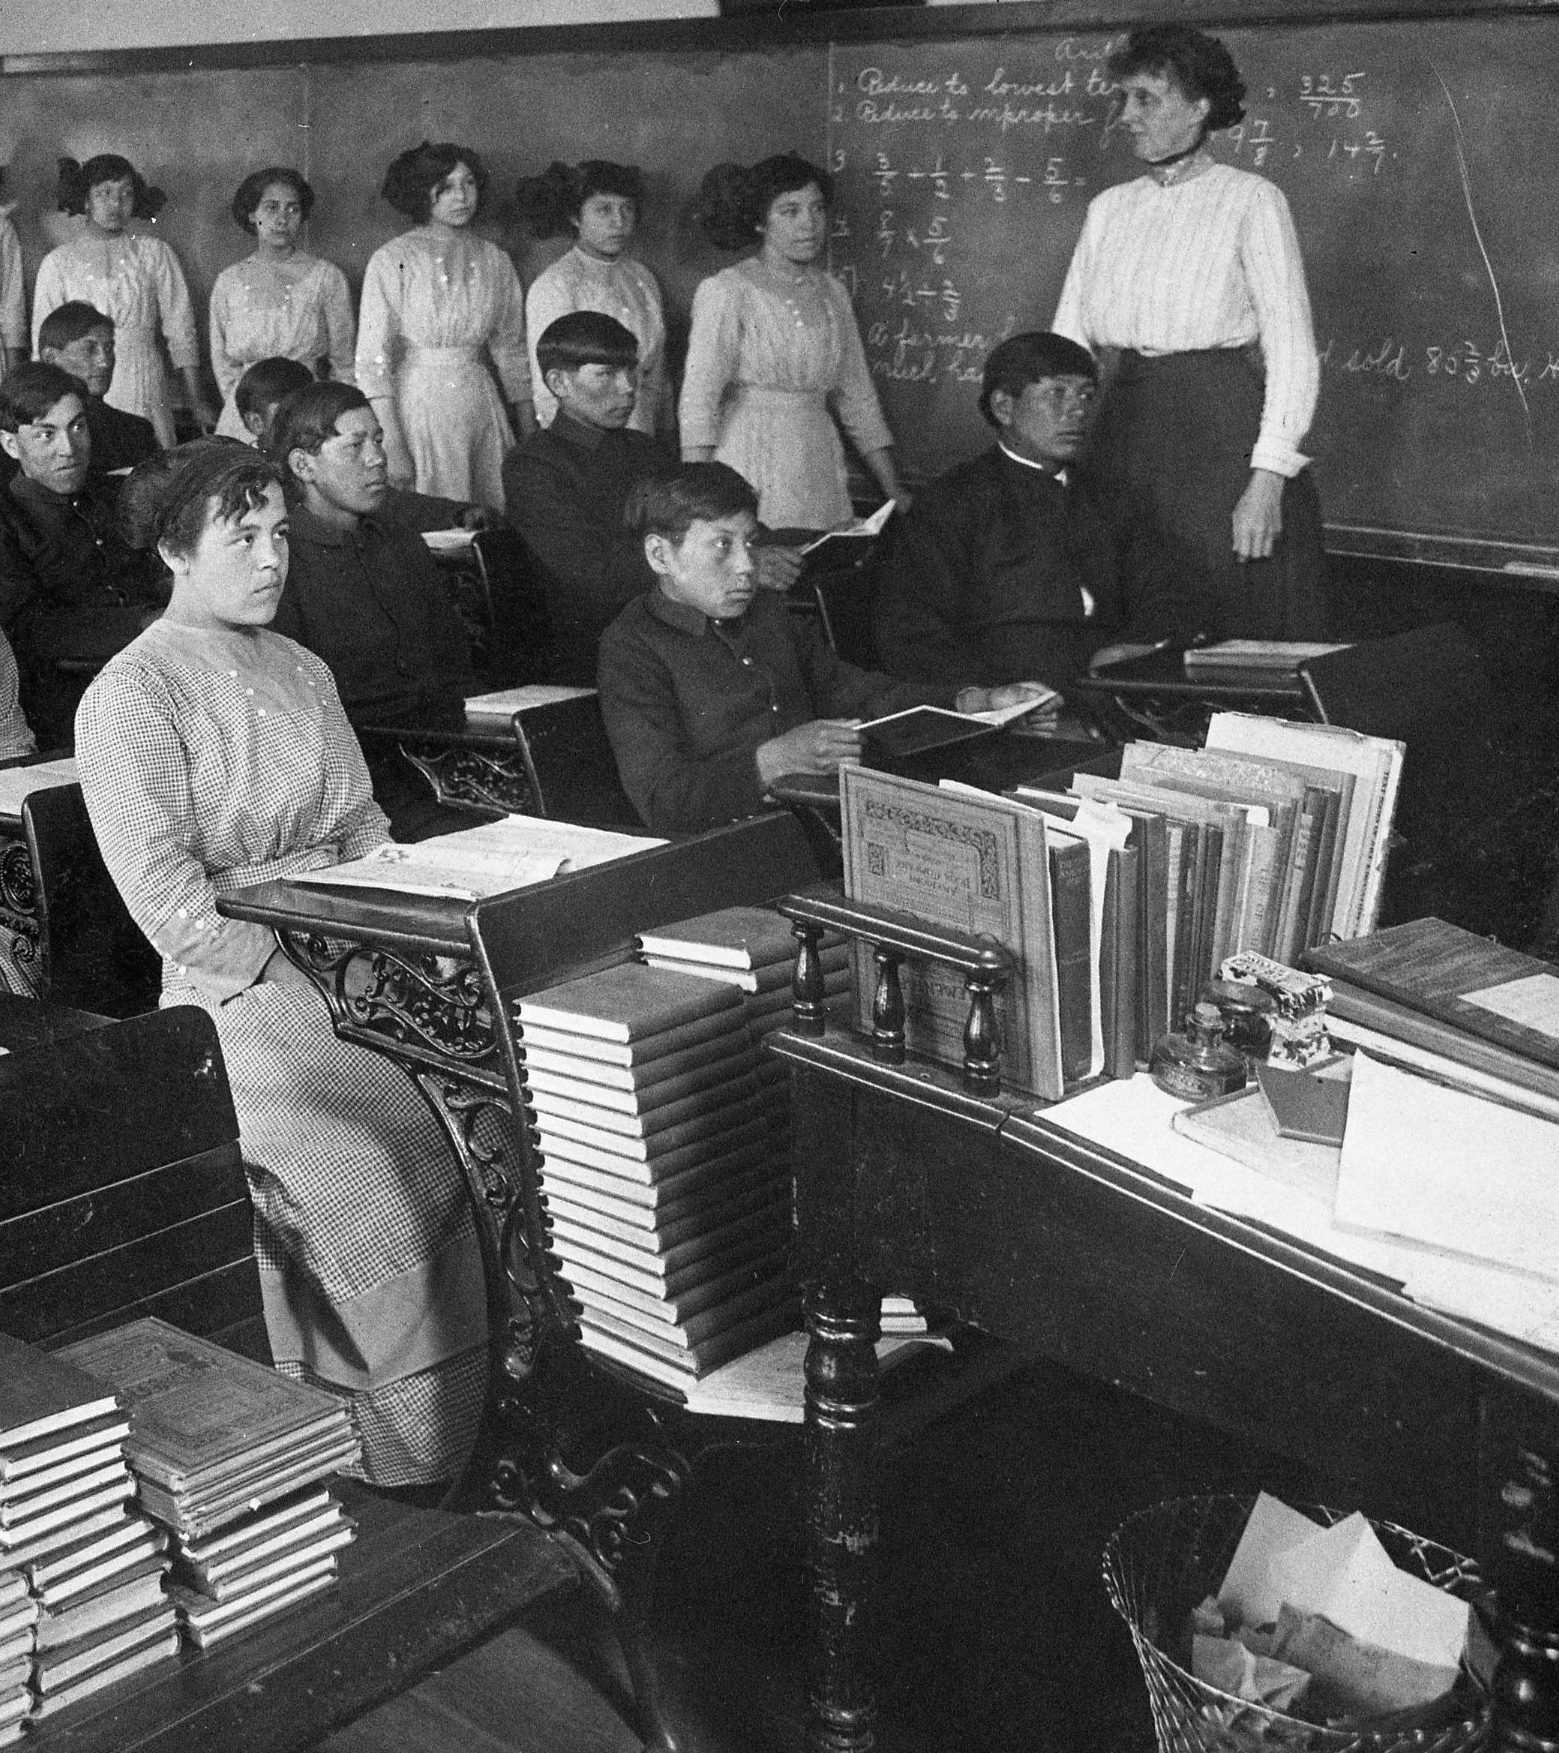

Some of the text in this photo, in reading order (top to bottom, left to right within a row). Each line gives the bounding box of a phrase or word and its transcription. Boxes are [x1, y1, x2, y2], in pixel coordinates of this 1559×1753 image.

[944, 71, 968, 94] to
[984, 67, 1074, 95] lowest
[940, 97, 959, 121] to
[1343, 338, 1411, 380] sold
